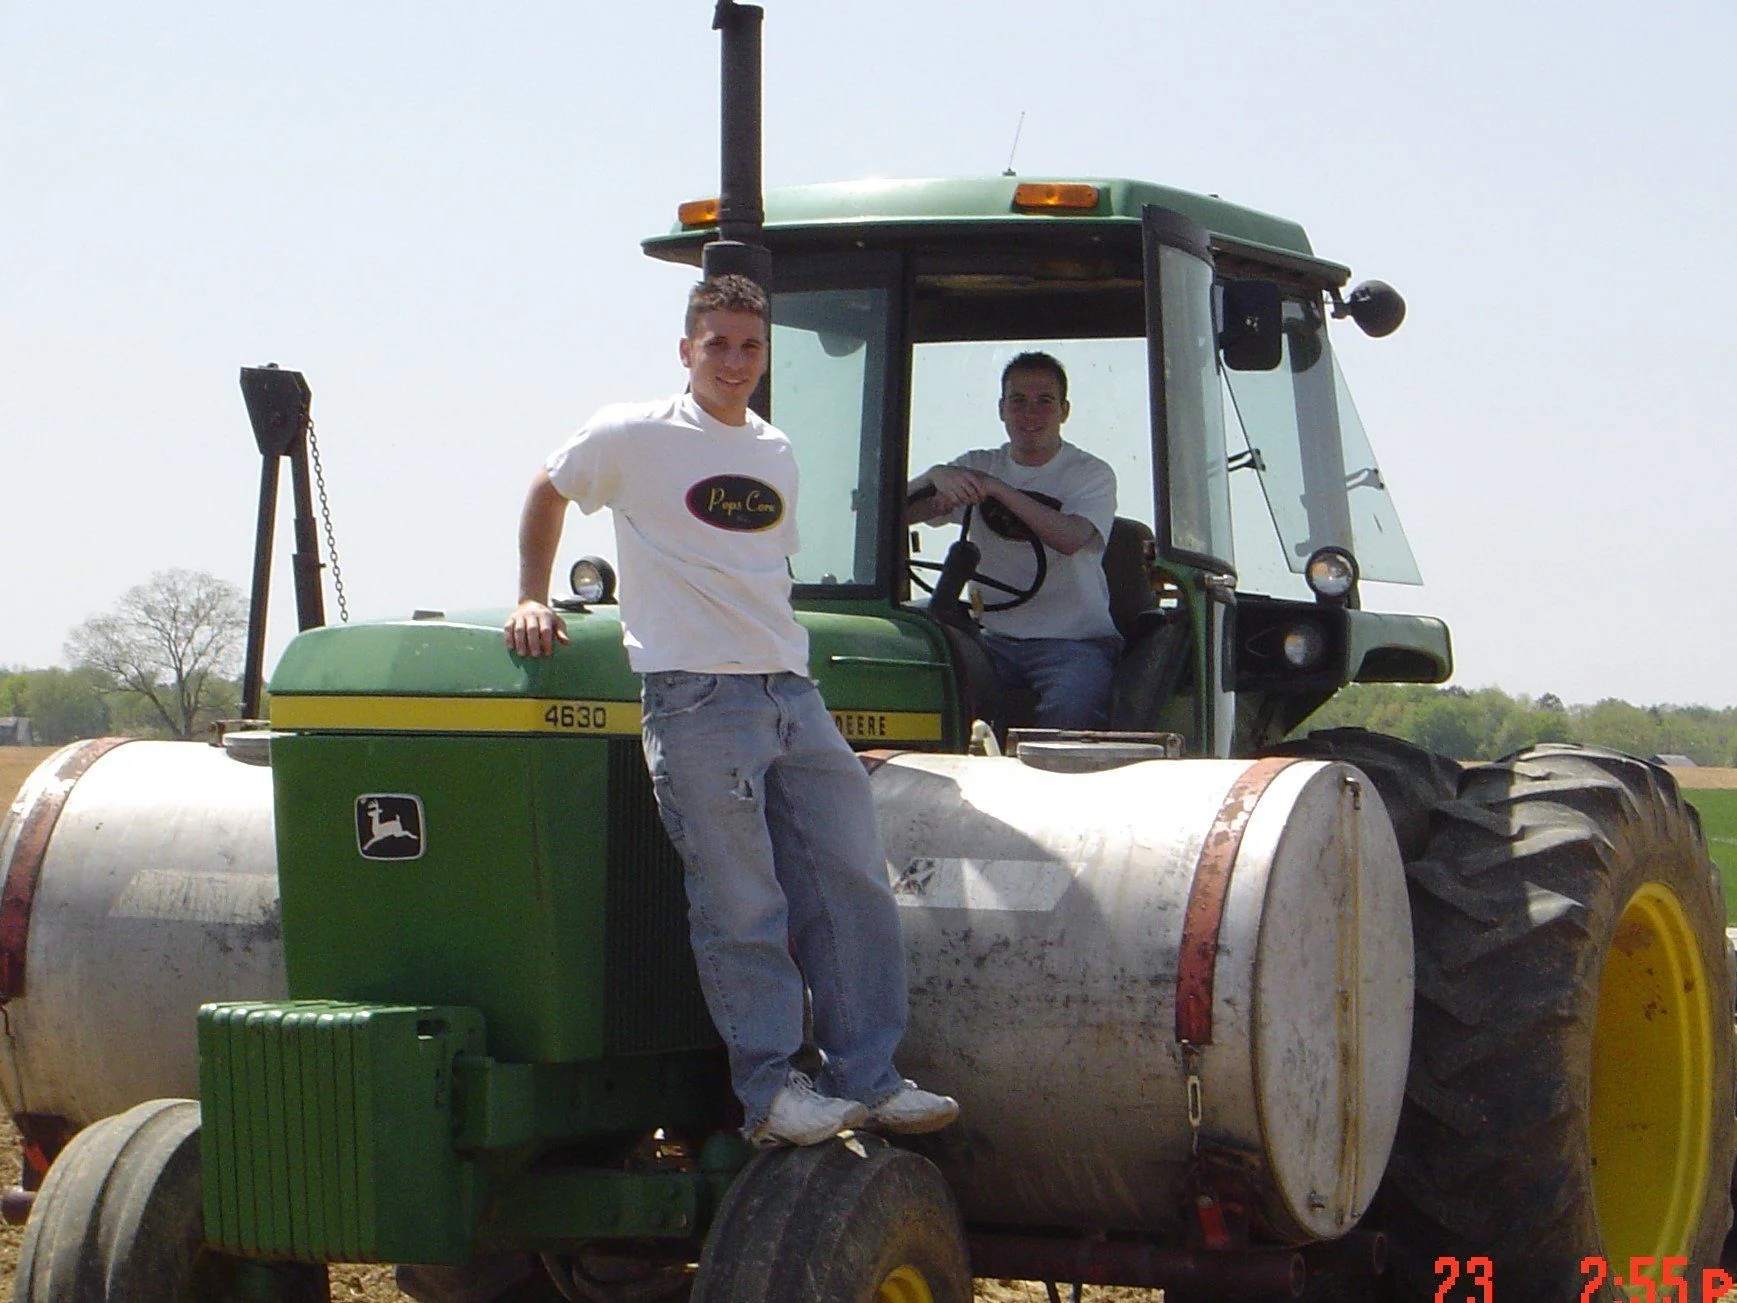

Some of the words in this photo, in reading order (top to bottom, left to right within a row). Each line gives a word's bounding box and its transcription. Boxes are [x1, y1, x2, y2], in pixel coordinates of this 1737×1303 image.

[707, 487, 742, 516] Pops
[544, 705, 606, 729] 4630
[835, 714, 886, 736] DEERE
